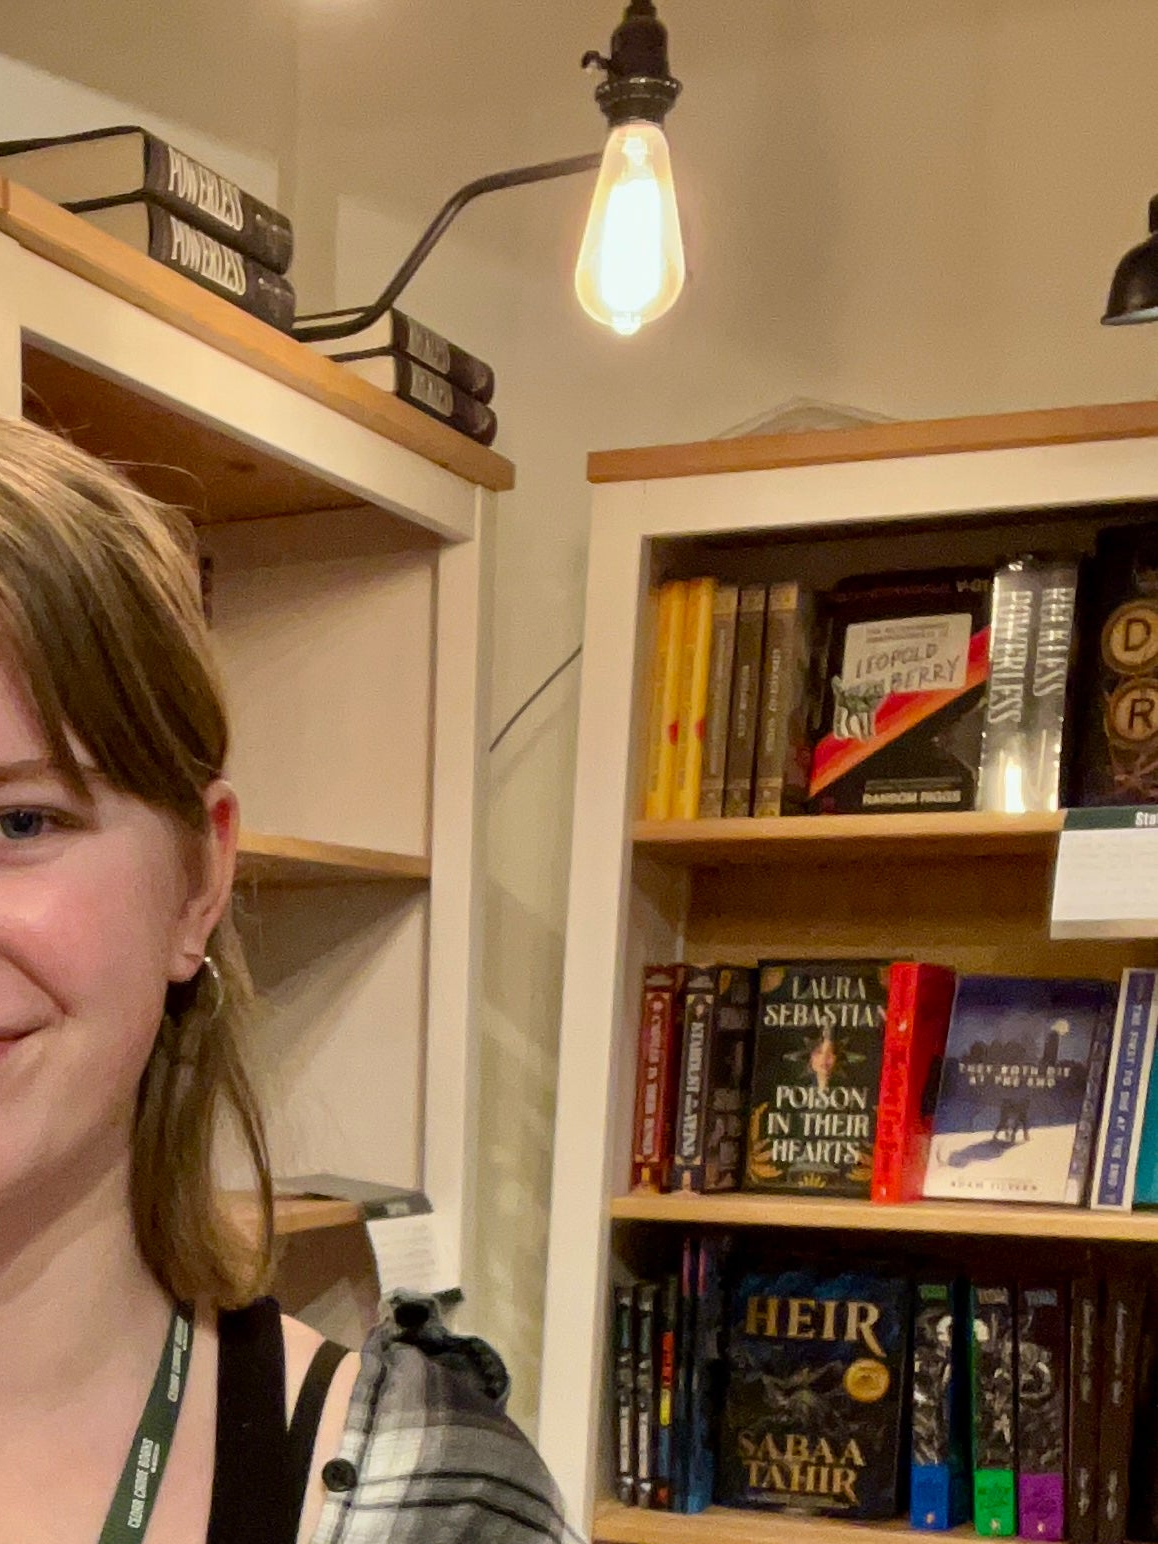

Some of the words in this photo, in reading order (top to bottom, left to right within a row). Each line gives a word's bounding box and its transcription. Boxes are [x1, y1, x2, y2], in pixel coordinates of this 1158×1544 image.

[1135, 811, 1158, 826] Sta
[791, 975, 866, 1000] LAURA
[763, 1003, 887, 1028] SEBASTIAN
[776, 1085, 868, 1110] POISON
[768, 1112, 790, 1135] IN
[800, 1112, 870, 1138] THEIR
[772, 1139, 860, 1165] HEARTS
[746, 1294, 887, 1358] HEIR
[742, 1432, 865, 1467] SABAA
[747, 1458, 858, 1505] TAHIR
